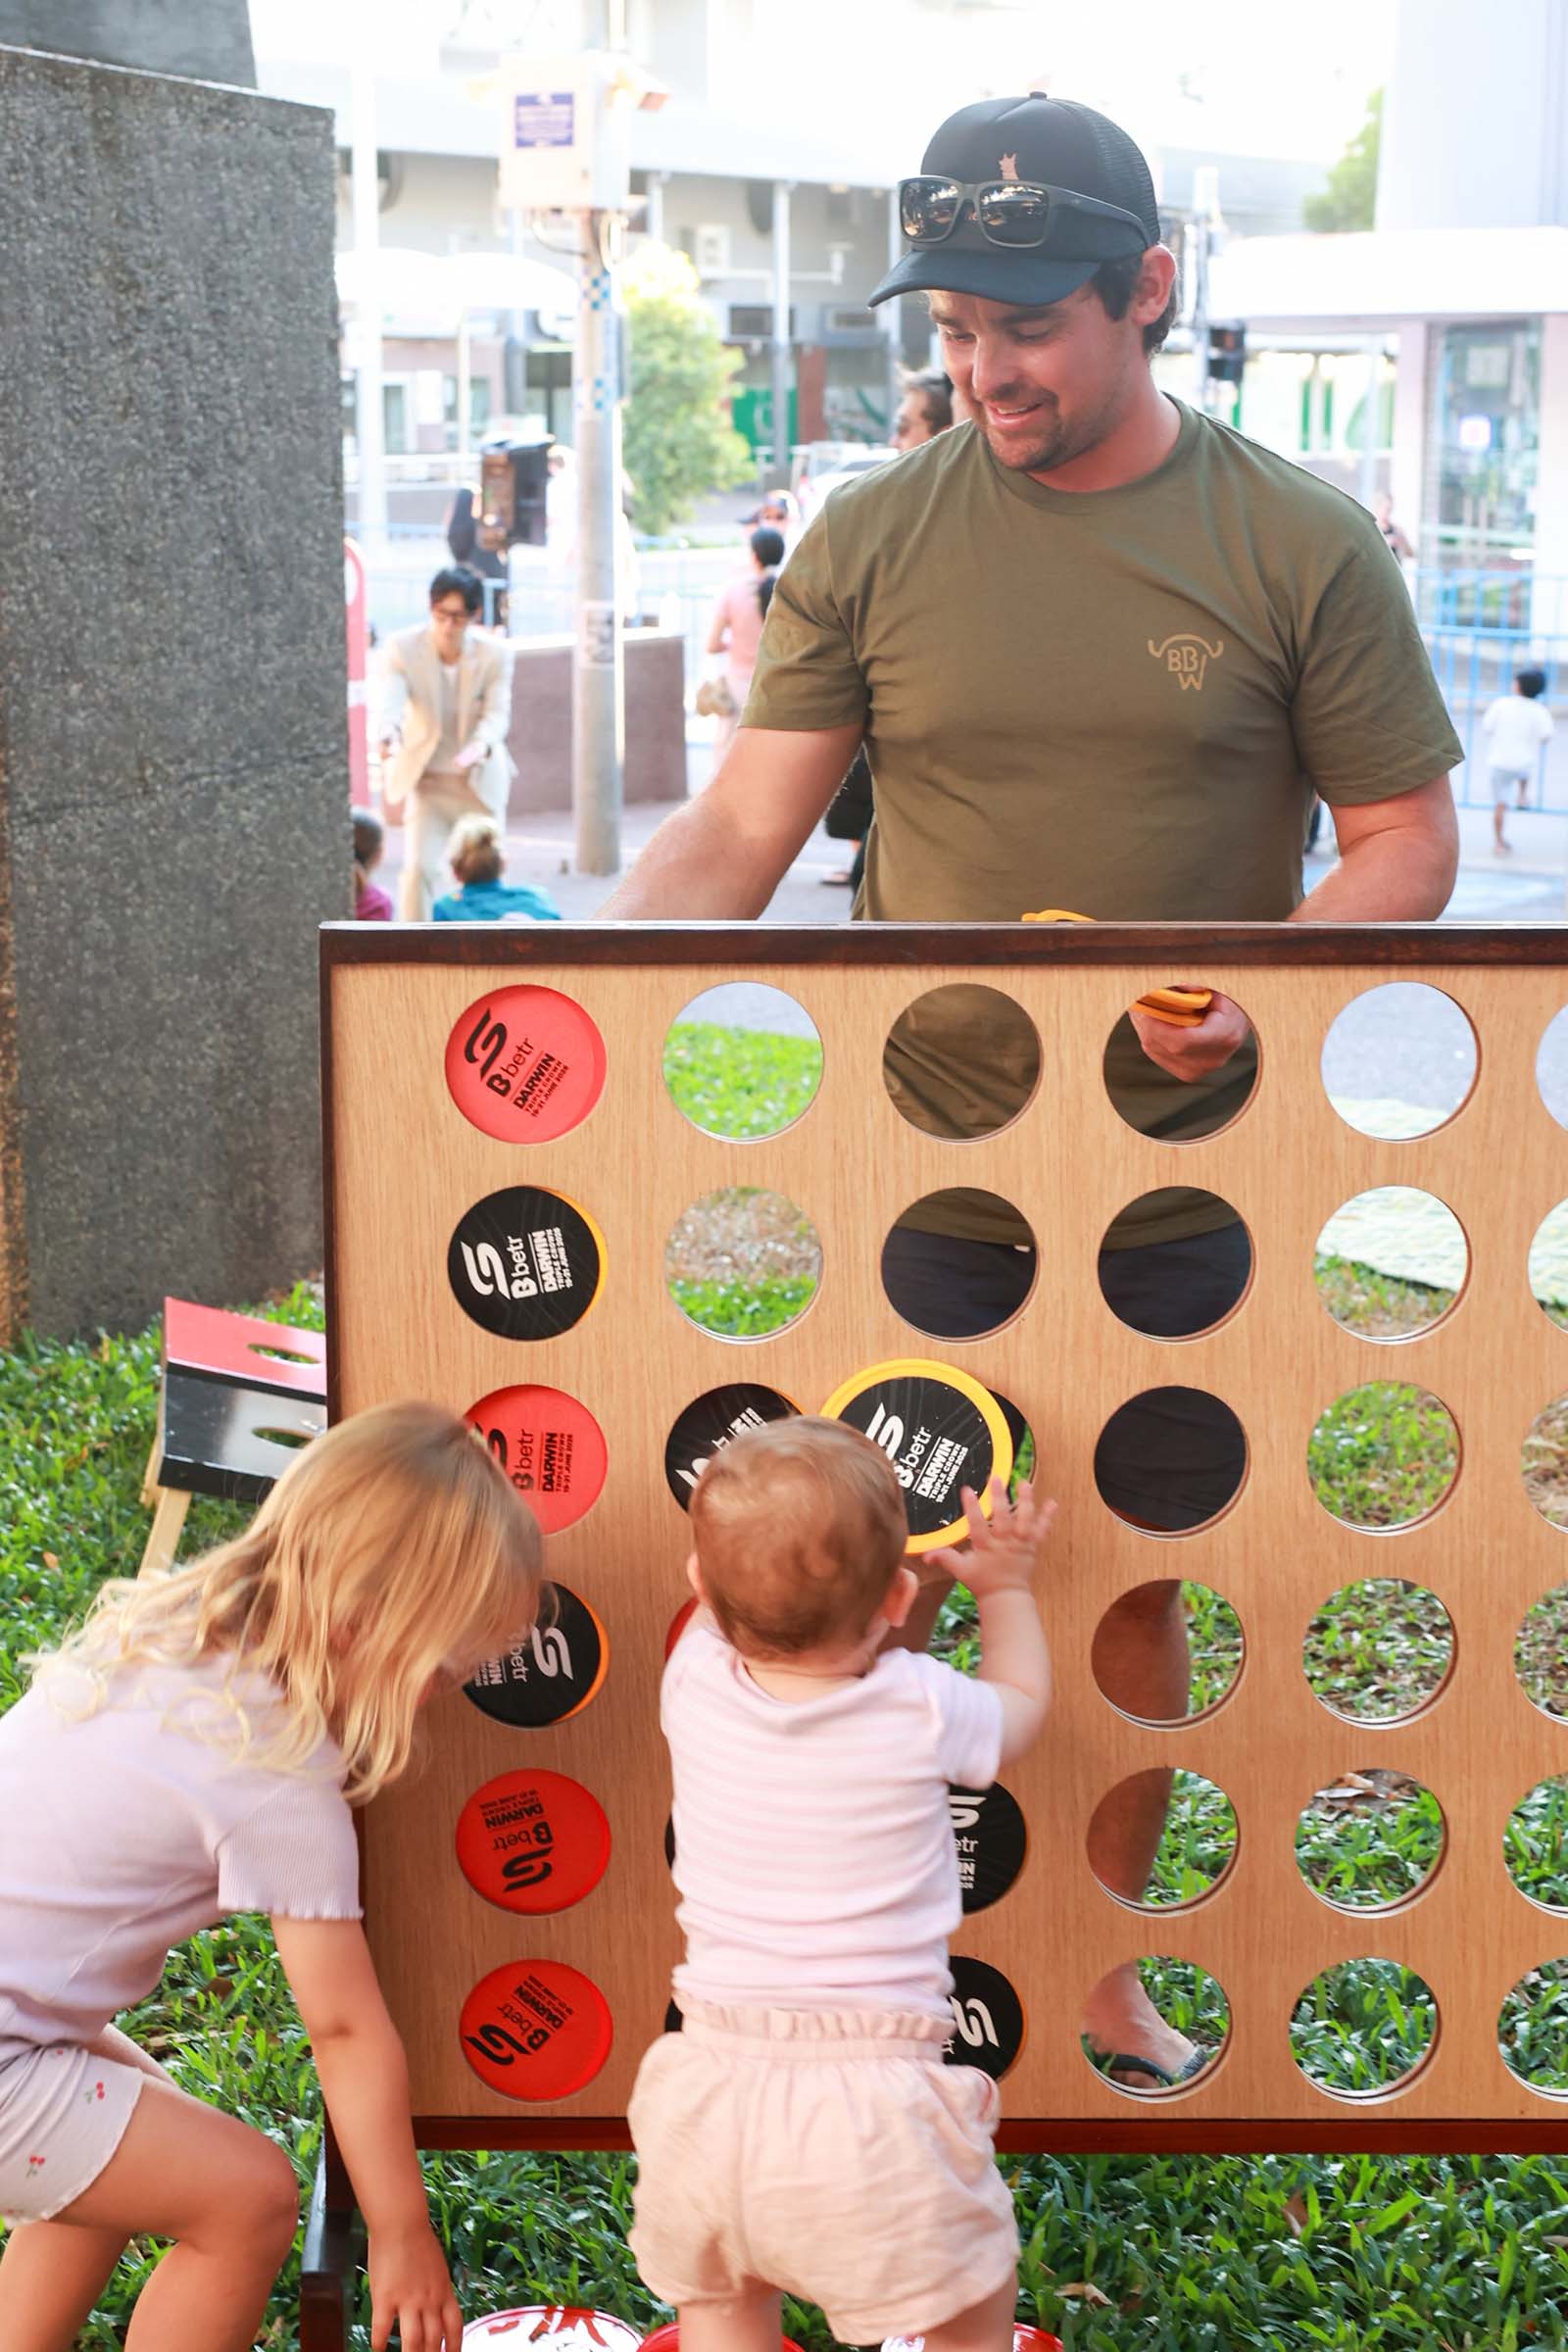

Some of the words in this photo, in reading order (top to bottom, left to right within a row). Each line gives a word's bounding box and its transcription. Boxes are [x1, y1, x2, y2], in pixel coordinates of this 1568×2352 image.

[513, 1053, 556, 1109] DARWIN
[531, 1230, 559, 1293] DARWIN
[542, 1432, 558, 1493] DARWIN
[915, 1438, 955, 1497] DARWIN
[928, 1472, 947, 1500] TRIPLE
[943, 1443, 961, 1472] CROWN
[945, 1463, 959, 1485] JUNE
[485, 1803, 544, 1829] DARWIN
[514, 1984, 564, 2030] DARWIN
